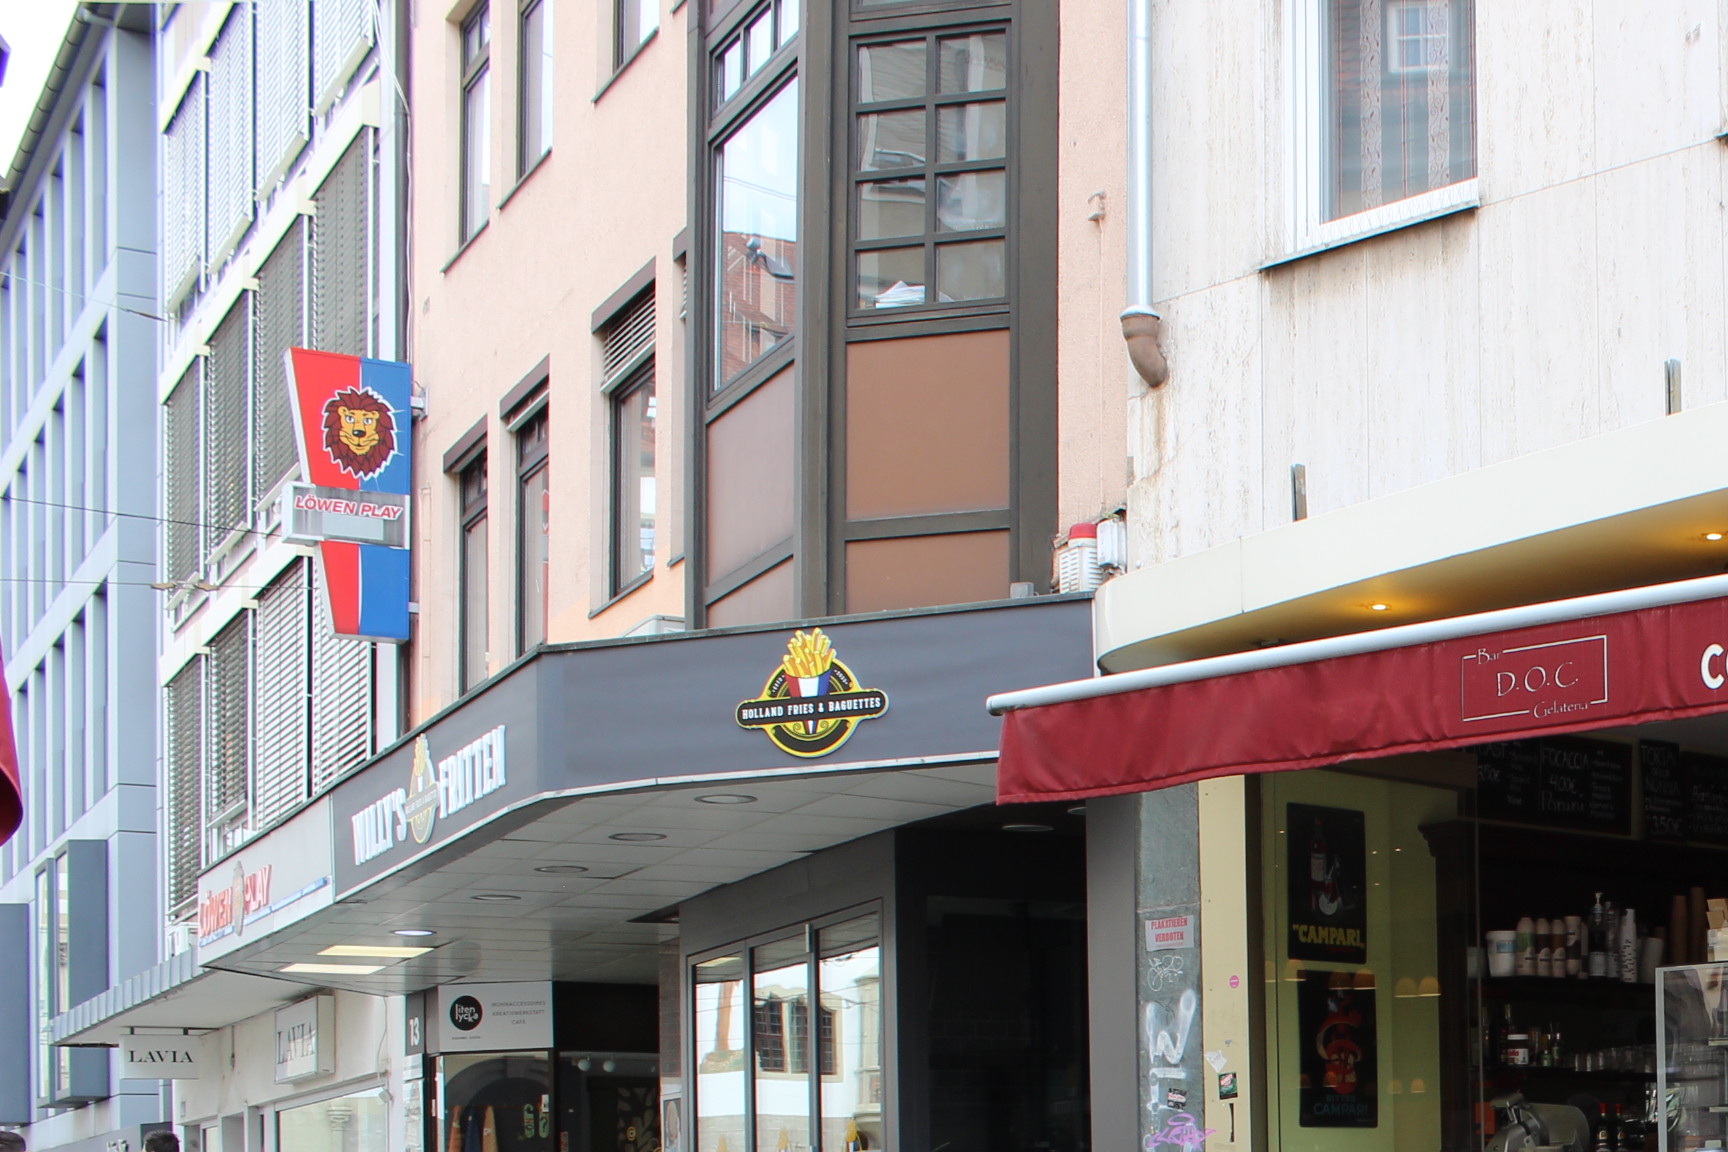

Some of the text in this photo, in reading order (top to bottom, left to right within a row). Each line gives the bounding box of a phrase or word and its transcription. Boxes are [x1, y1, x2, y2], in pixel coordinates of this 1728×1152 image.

[295, 496, 402, 518] LÖWEN PLAY
[1478, 648, 1501, 665] Bar
[742, 697, 881, 720] HOLLAND FRIES & BAGUETTES
[352, 725, 506, 866] WILLY'S FRITTEN
[1151, 918, 1187, 930] PLAKATIEREN
[1155, 931, 1184, 943] VERBOTEN
[409, 1016, 420, 1046] 13
[277, 1022, 315, 1065] LAVIA
[128, 1050, 194, 1063] LAVIA
[1313, 1102, 1369, 1116] CAMPARI
